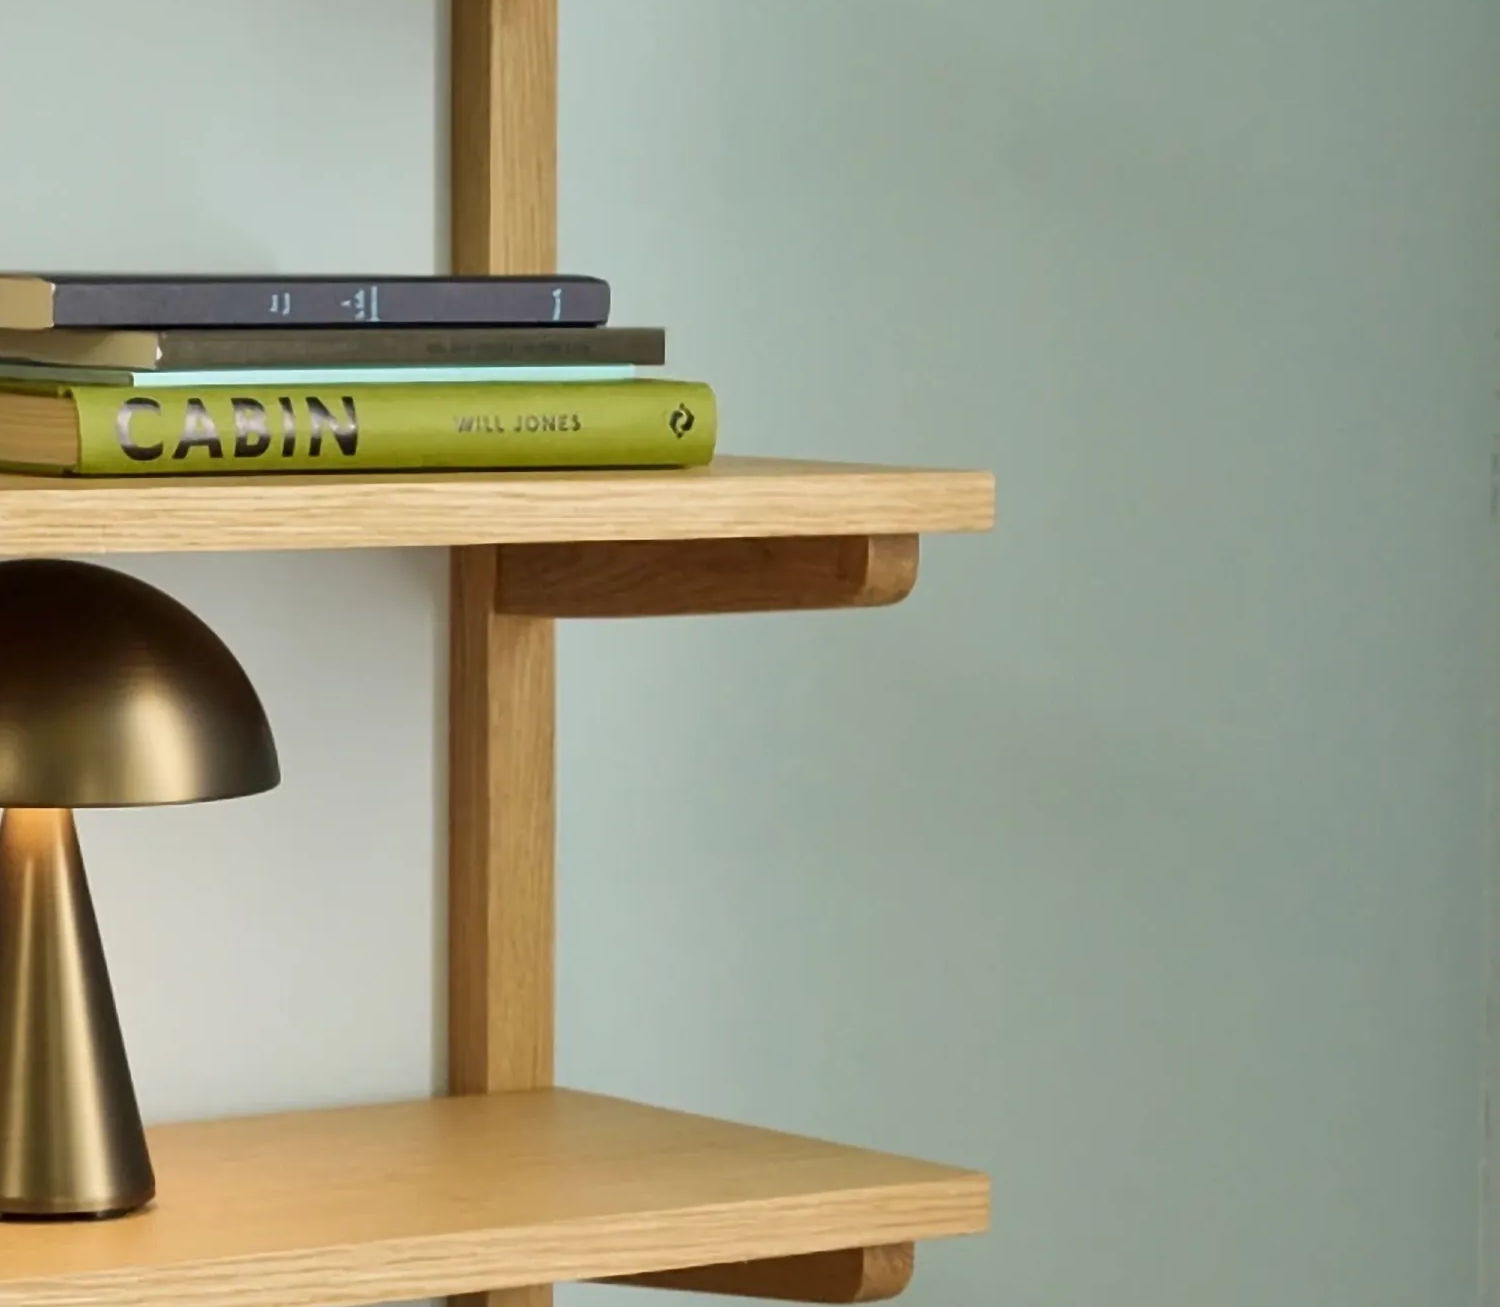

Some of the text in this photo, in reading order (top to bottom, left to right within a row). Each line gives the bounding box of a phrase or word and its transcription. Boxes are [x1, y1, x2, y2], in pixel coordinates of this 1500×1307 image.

[116, 396, 359, 461] CABIN
[454, 414, 582, 434] WILL JONES
